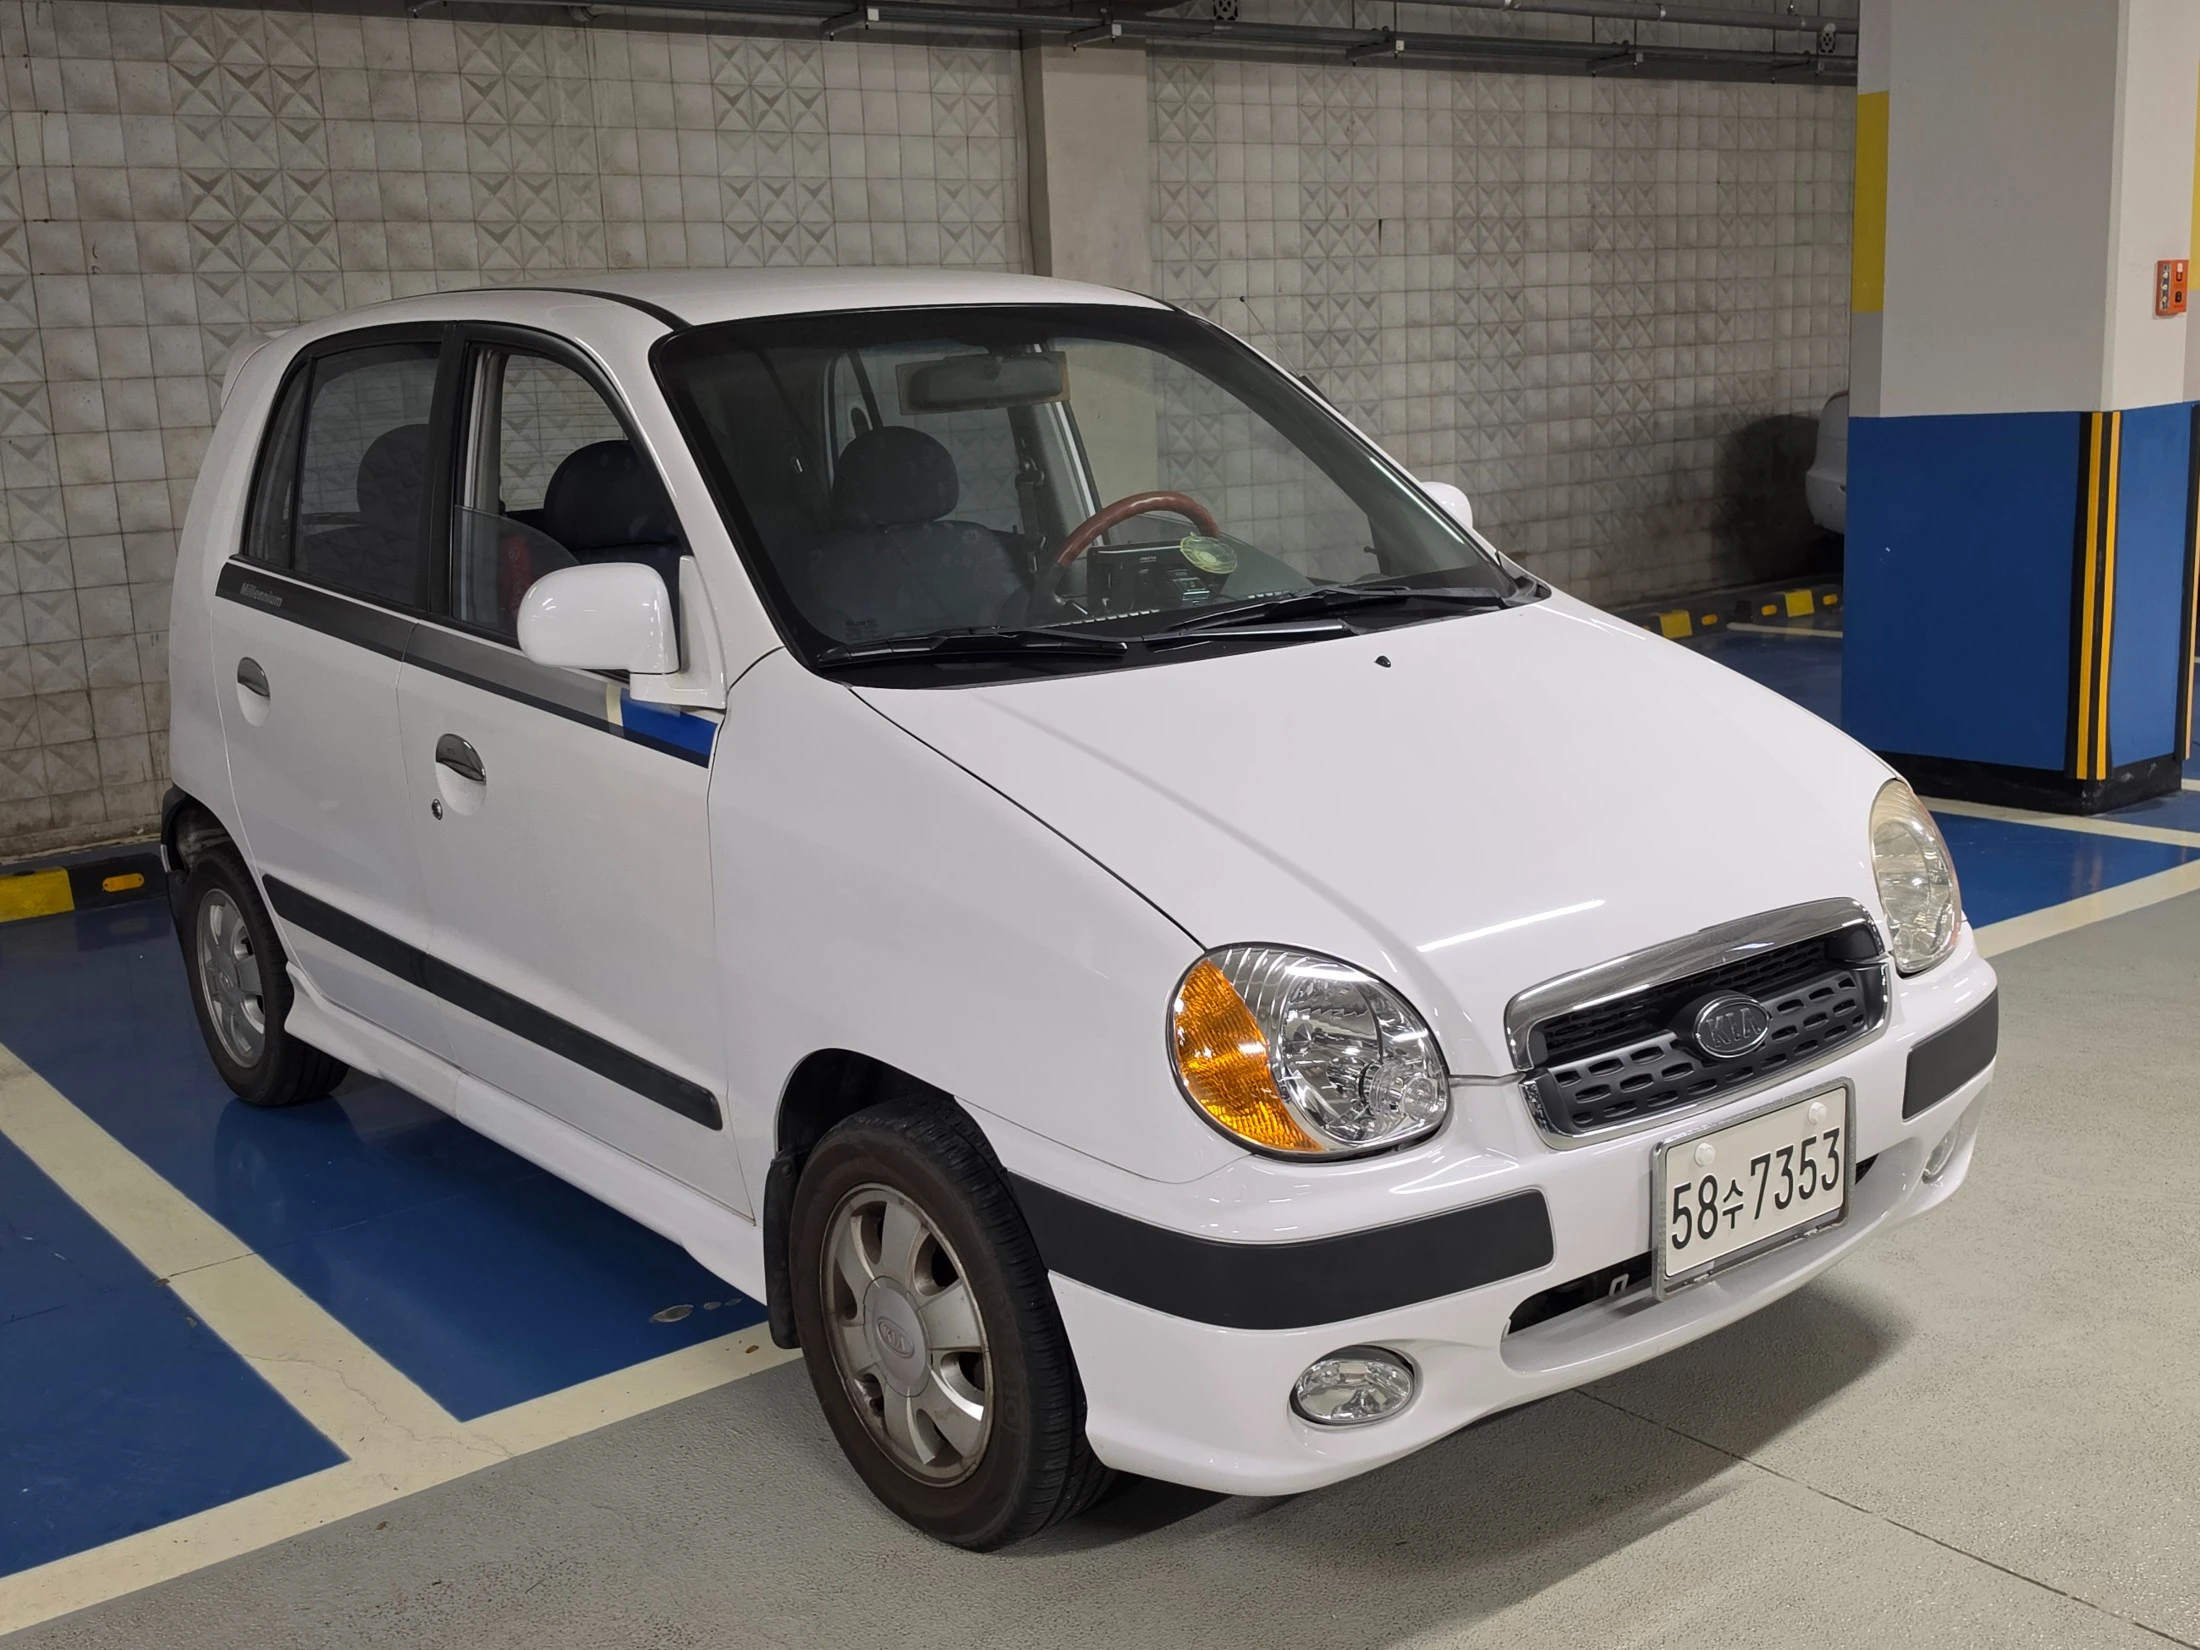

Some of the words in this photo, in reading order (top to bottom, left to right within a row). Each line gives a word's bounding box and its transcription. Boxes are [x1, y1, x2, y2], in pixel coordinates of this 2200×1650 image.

[240, 582, 283, 608] Millennium
[1705, 1007, 1762, 1048] KIA
[880, 1322, 911, 1352] KIA
